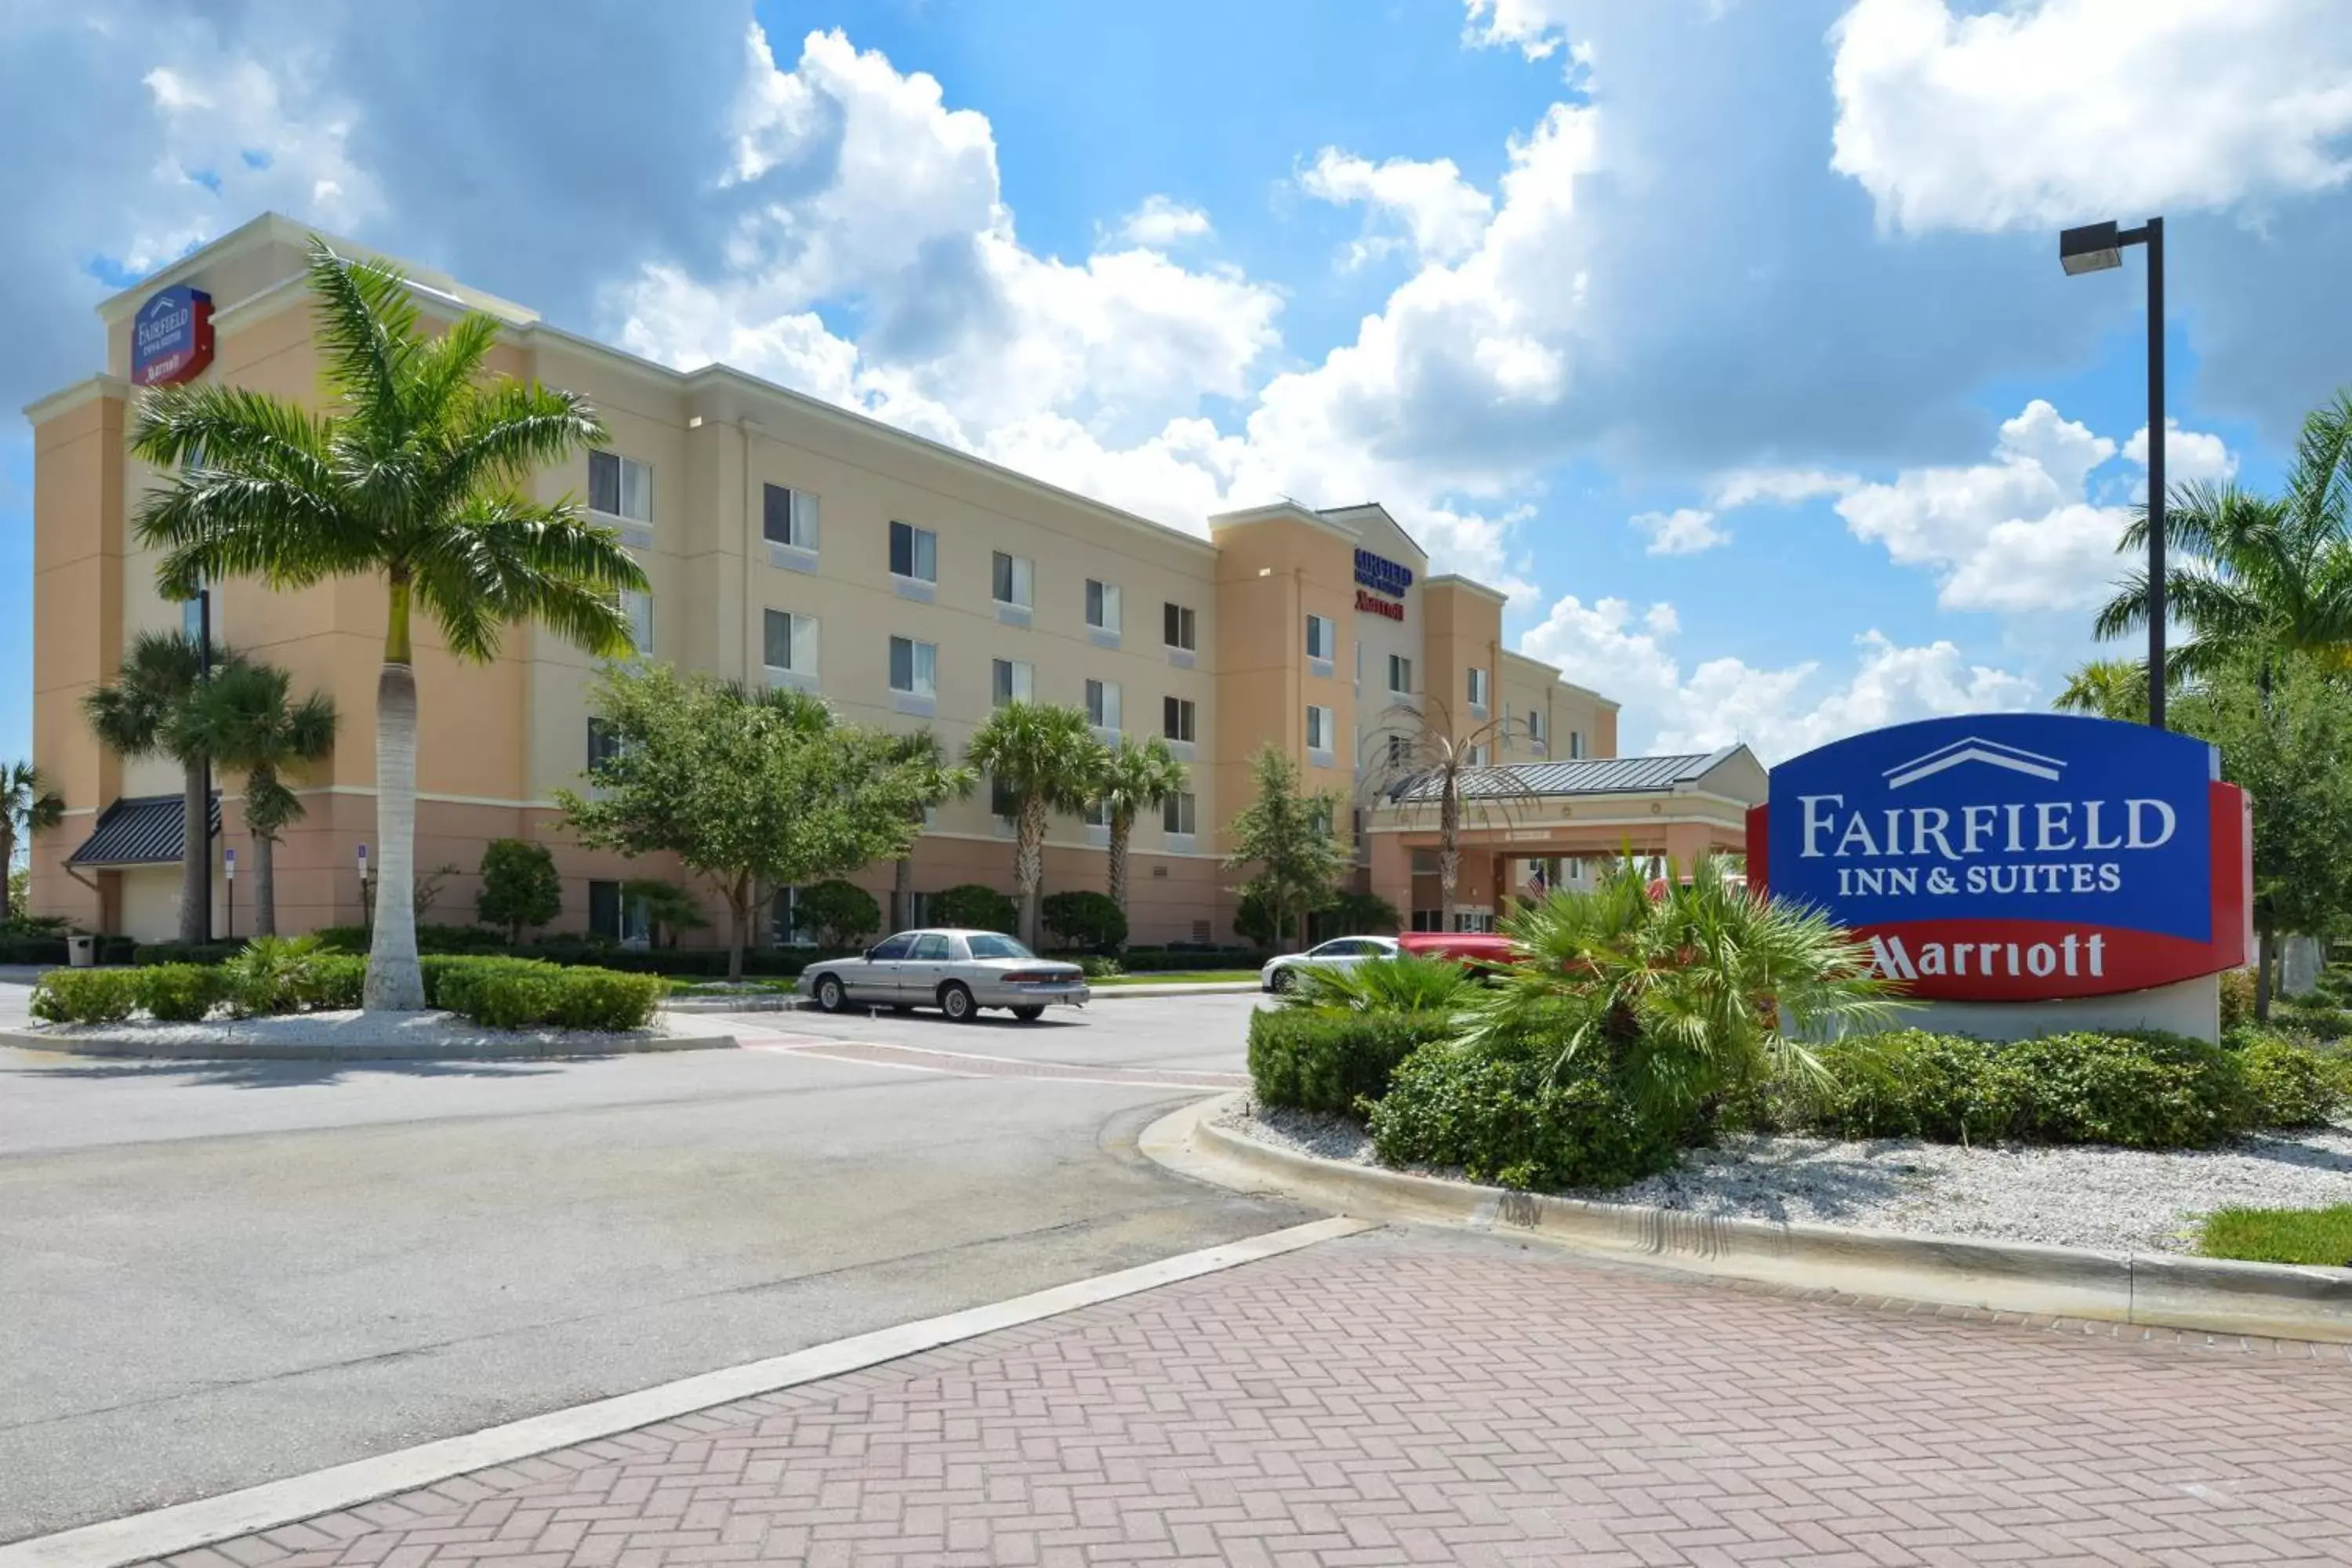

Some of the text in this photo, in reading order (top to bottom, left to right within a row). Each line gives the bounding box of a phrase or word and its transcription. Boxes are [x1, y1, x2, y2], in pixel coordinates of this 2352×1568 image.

[139, 307, 187, 347] FAIRFIELD
[1797, 794, 2176, 860] FAIRFIELD
[1838, 862, 2122, 896] INN & SUITES
[1862, 933, 2106, 980] Marriott
